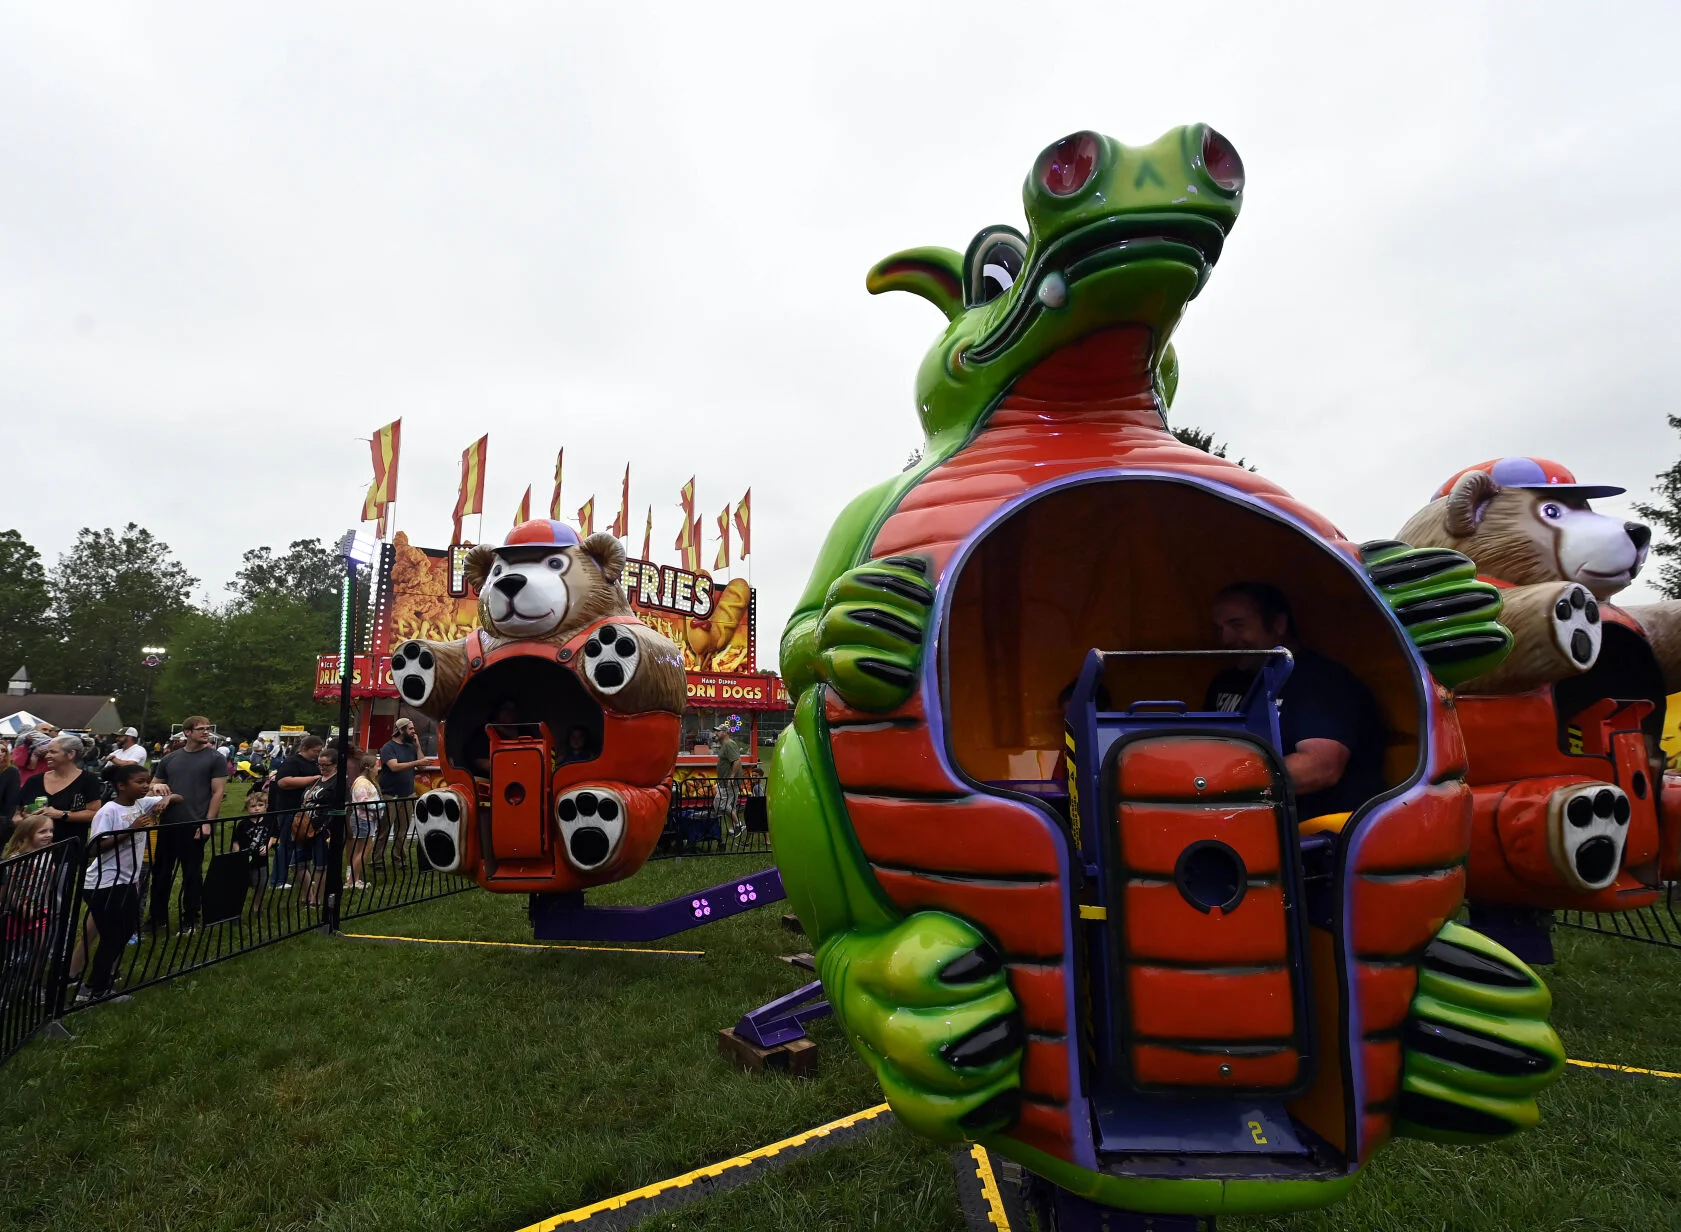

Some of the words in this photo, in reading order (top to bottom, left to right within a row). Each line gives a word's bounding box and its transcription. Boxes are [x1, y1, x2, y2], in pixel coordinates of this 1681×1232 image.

[620, 561, 711, 615] FRIES
[319, 669, 362, 685] DRINS
[687, 683, 716, 698] ORN
[722, 685, 762, 699] DOGS
[1247, 1120, 1268, 1145] 2
